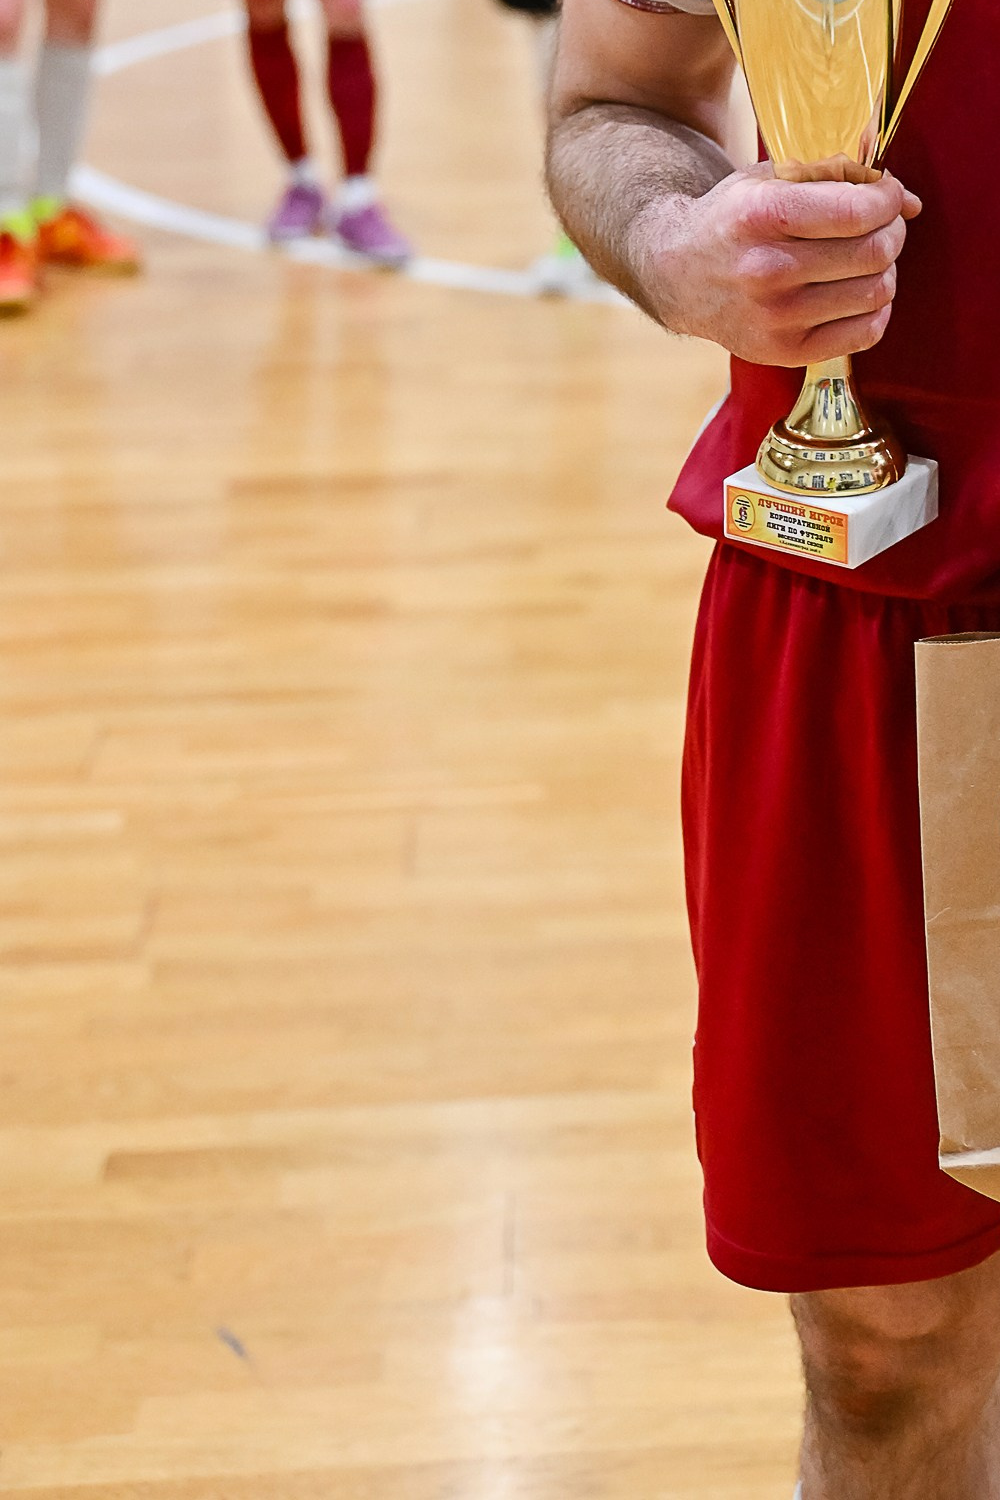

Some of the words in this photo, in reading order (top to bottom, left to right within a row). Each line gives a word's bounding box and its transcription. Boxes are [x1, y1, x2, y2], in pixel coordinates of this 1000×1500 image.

[758, 498, 806, 518] ЛУЧШИЙ
[809, 510, 844, 527] ИГРОК
[769, 512, 831, 533] КОРПОРАТИВНОЙ
[766, 522, 786, 533] ЛИГИ
[788, 526, 798, 535] ПО
